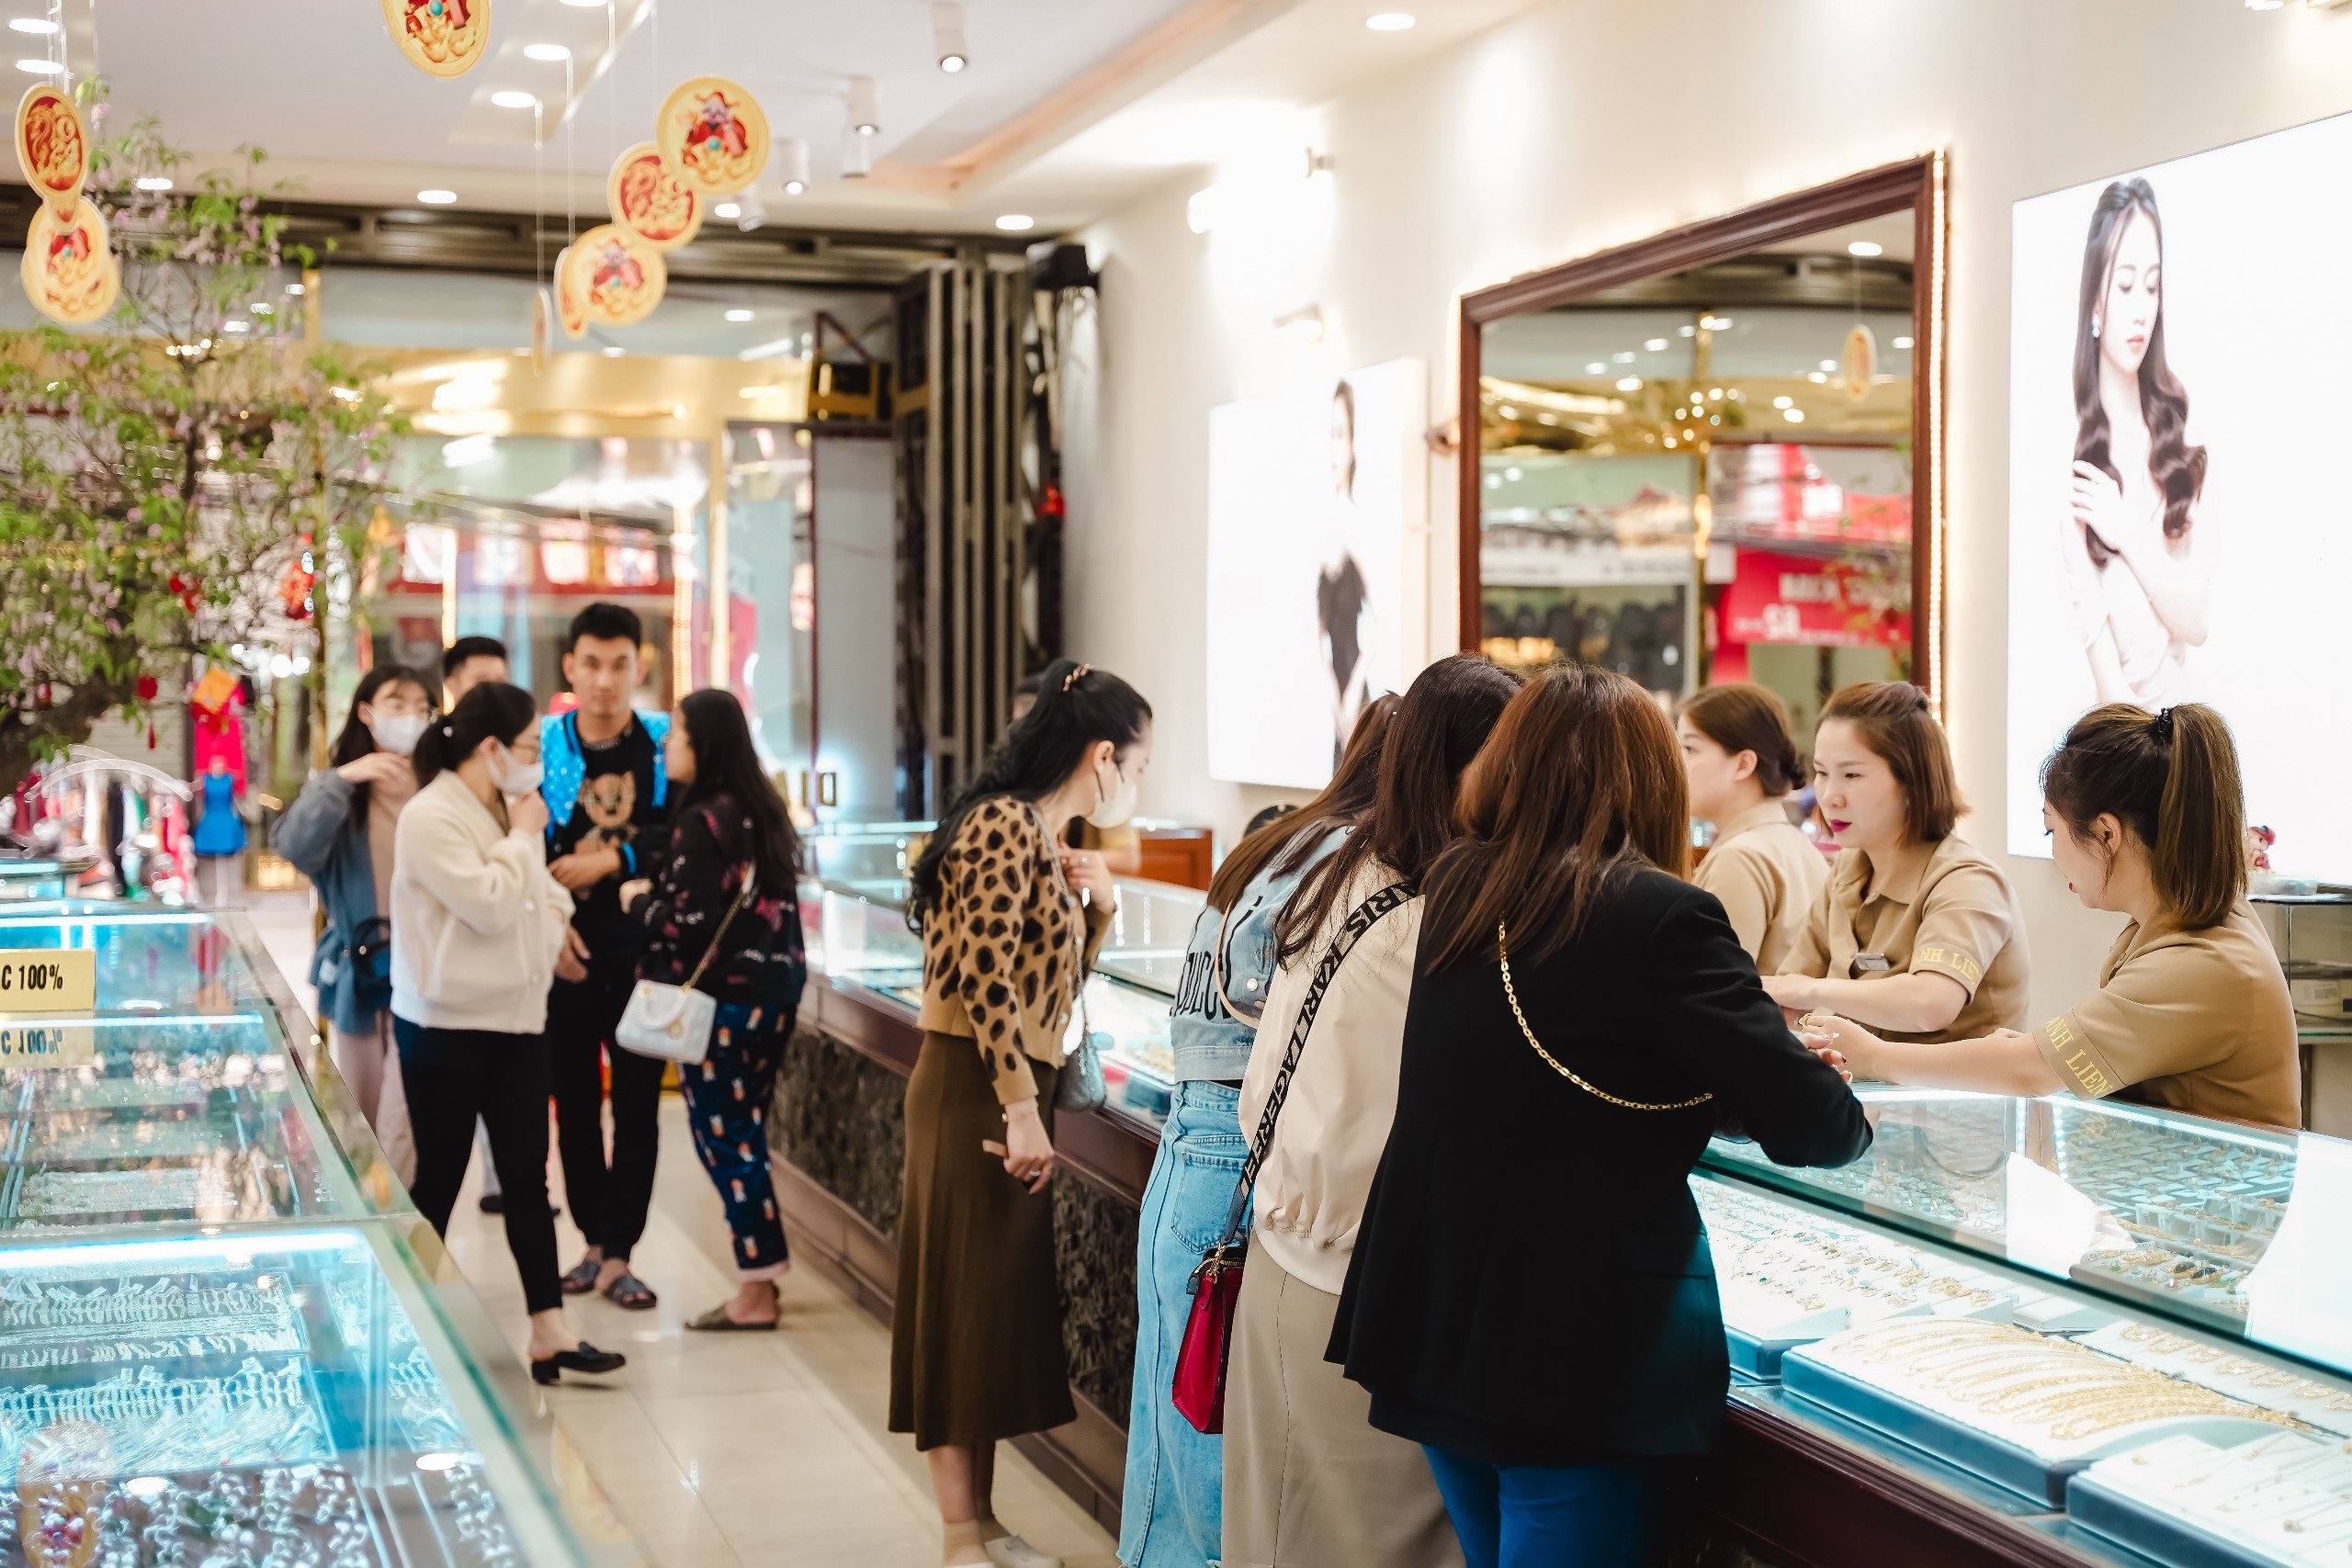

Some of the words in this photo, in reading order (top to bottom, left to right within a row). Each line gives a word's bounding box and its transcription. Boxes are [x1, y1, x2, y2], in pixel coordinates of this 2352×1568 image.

[18, 964, 63, 990] 100%
[1296, 942, 1342, 1025] KARL
[2065, 1049, 2113, 1096] LIEN
